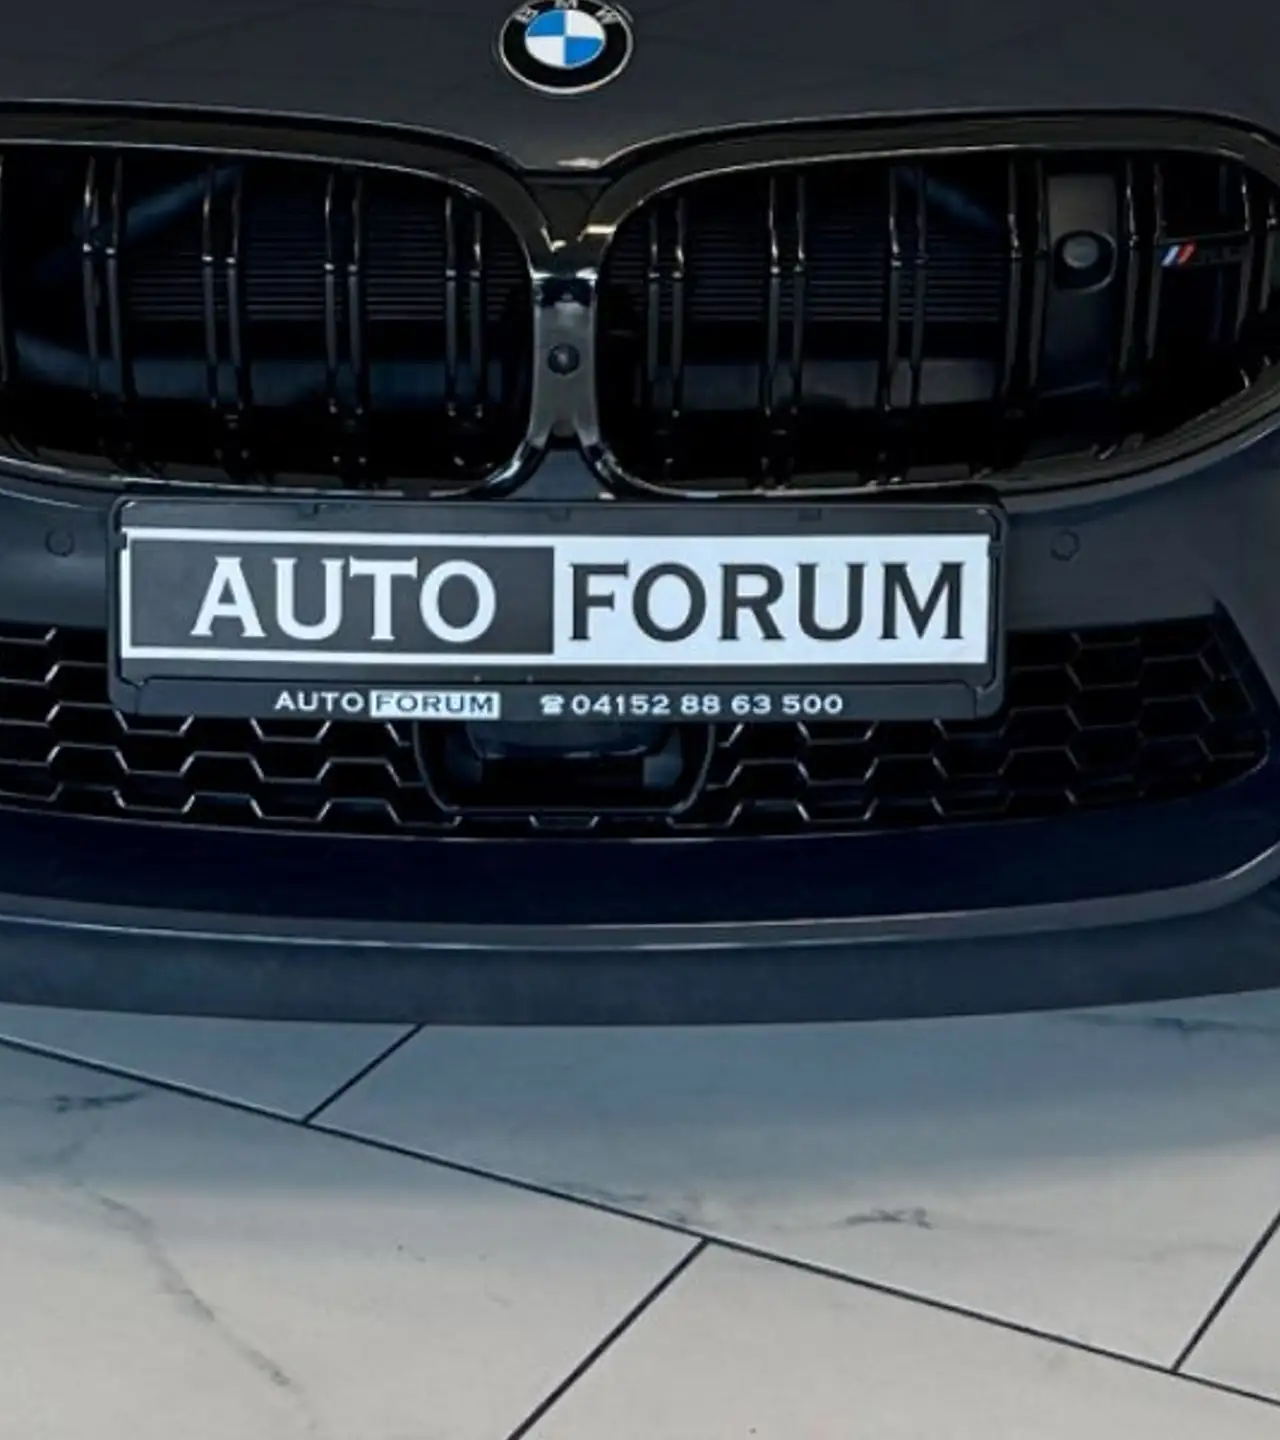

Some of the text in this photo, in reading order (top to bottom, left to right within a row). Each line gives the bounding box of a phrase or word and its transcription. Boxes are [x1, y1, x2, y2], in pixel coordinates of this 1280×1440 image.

[190, 555, 966, 644] AUTO FORUM
[275, 691, 844, 716] AUTO FORUM 04152 88 63 500
